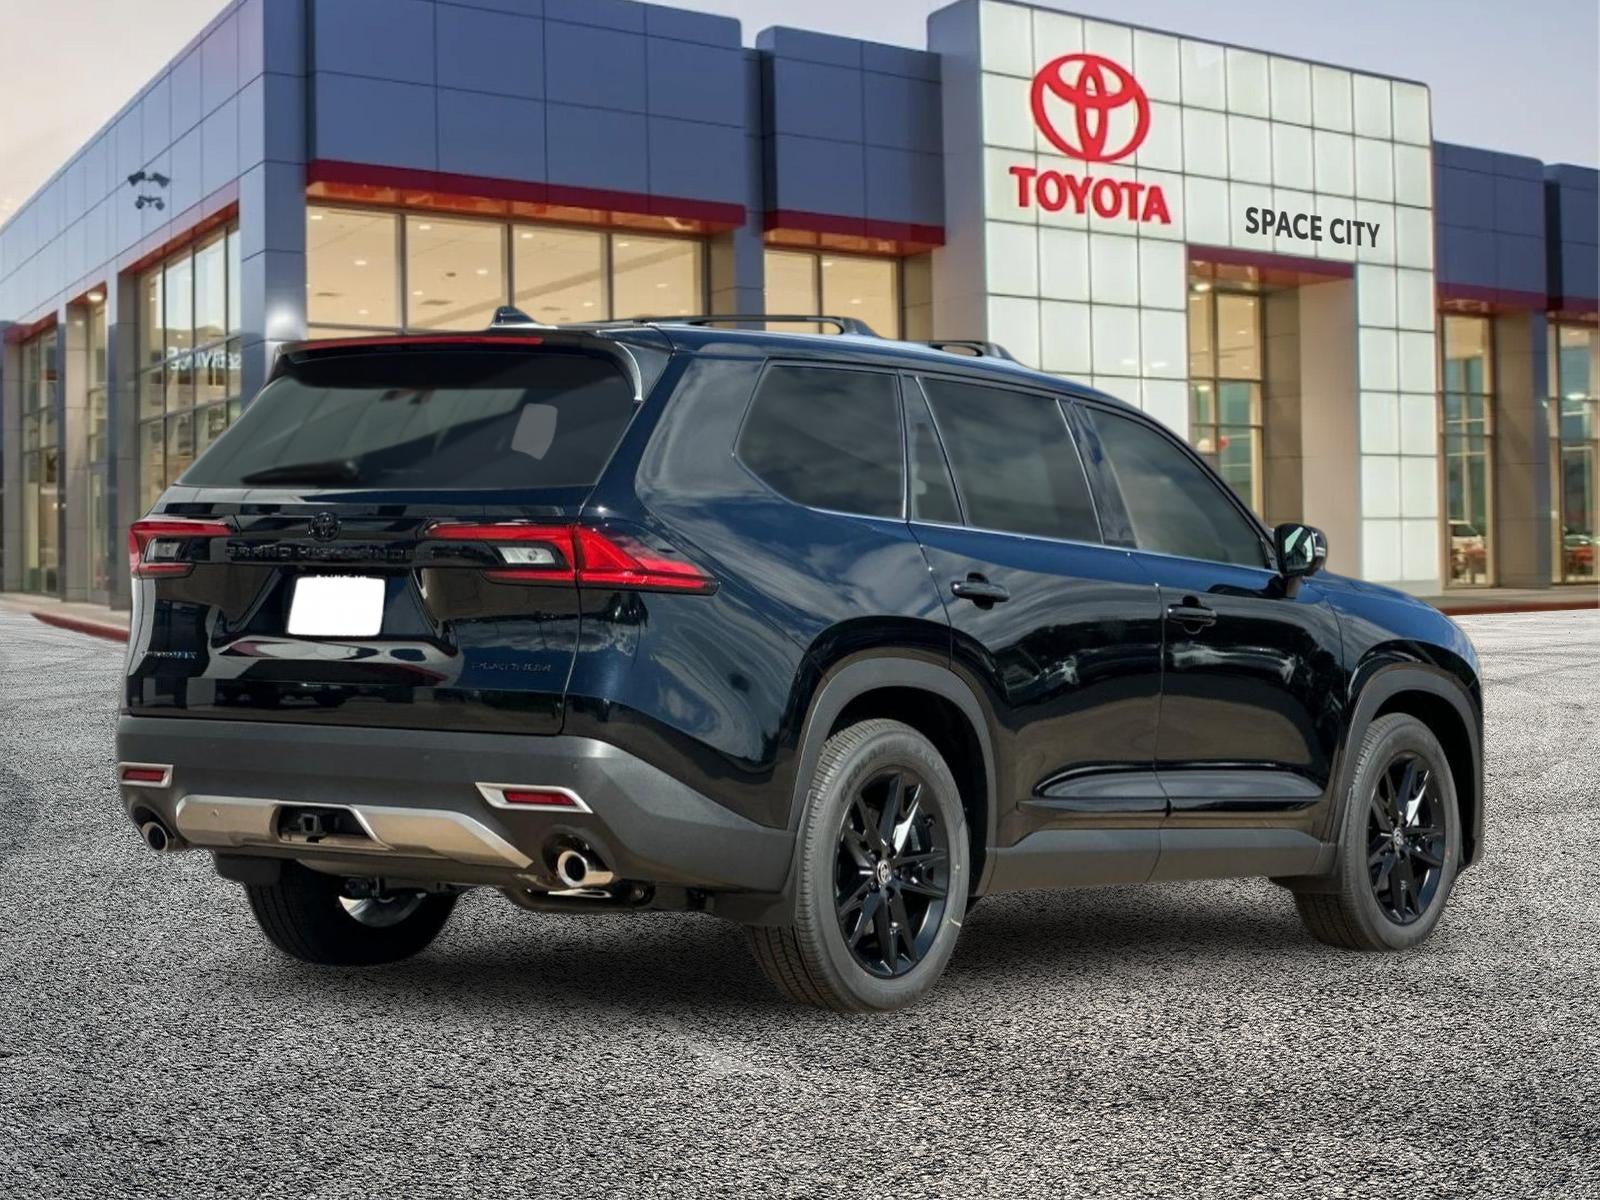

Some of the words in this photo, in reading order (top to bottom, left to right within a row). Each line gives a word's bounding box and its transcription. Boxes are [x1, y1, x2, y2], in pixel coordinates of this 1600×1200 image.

[1009, 166, 1171, 224] TOYOTA
[1245, 206, 1323, 242] SPACE
[1330, 218, 1381, 248] CITY
